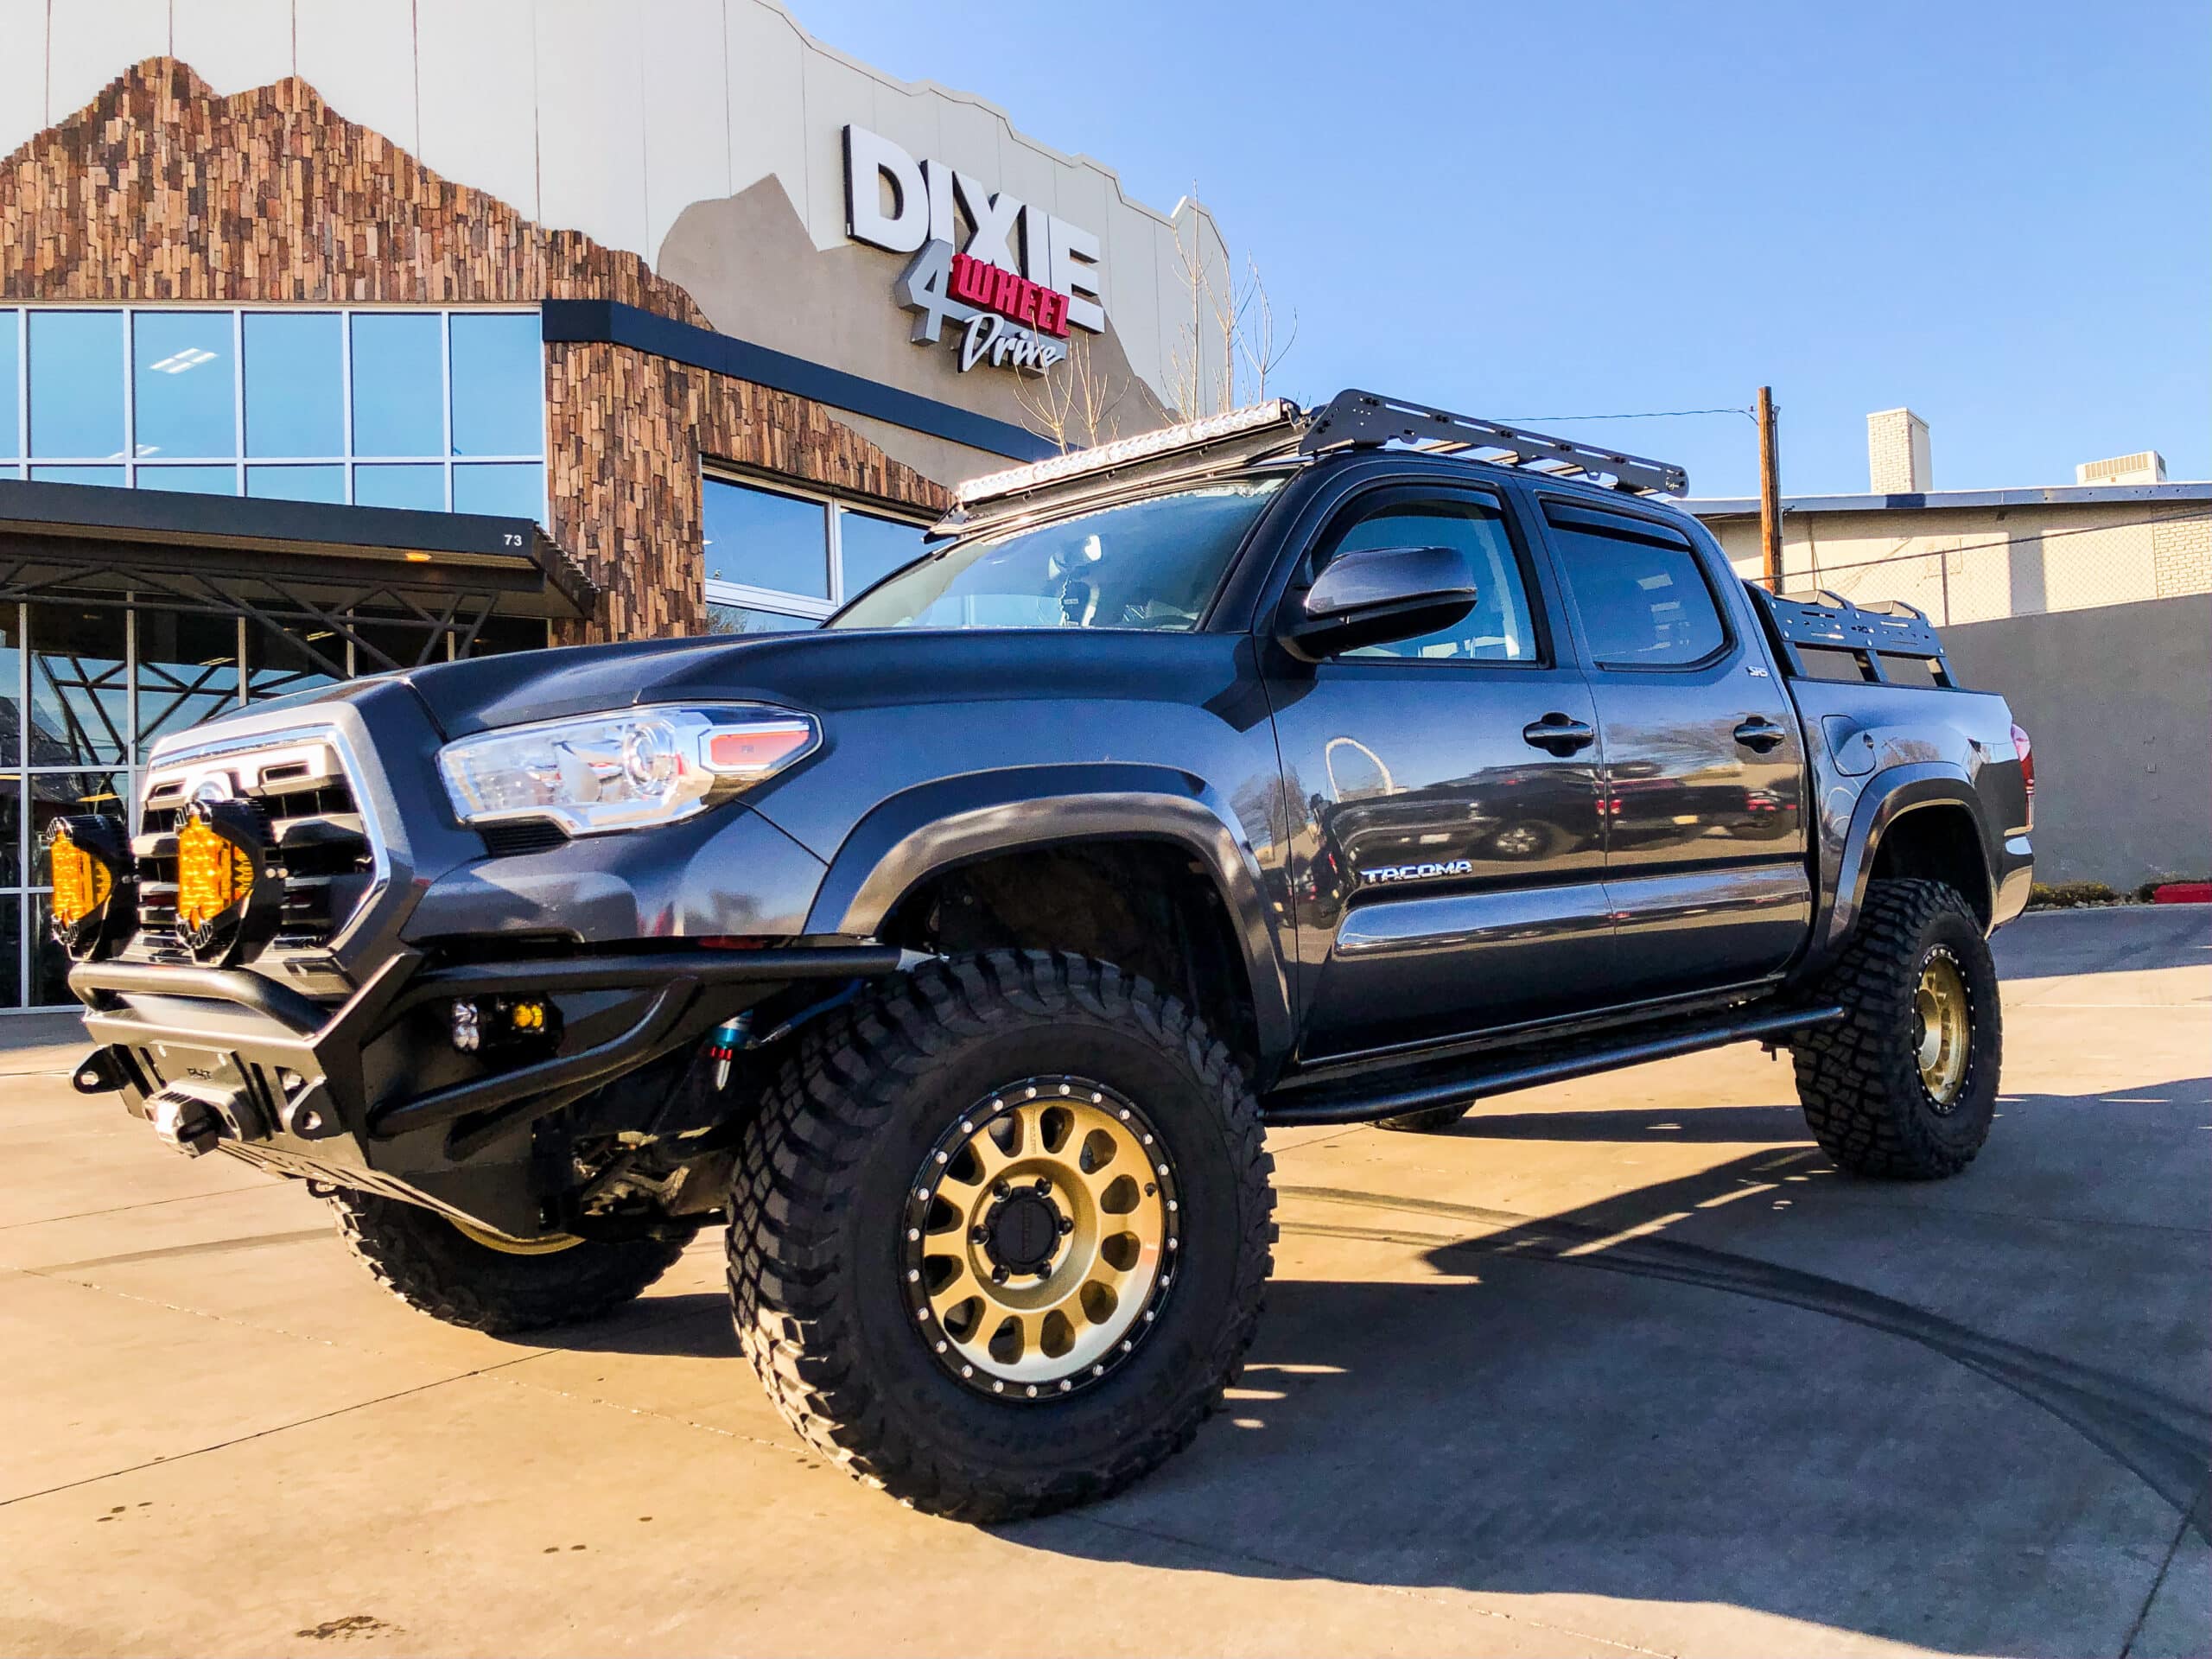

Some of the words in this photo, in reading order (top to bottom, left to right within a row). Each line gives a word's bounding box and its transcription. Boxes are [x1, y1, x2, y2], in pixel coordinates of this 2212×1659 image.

[844, 124, 1105, 334] DIXIE
[896, 238, 954, 346] 4
[951, 252, 1071, 339] WHEEL
[957, 313, 1066, 373] Drive
[504, 534, 523, 547] 73
[1360, 859, 1472, 883] TACOMA
